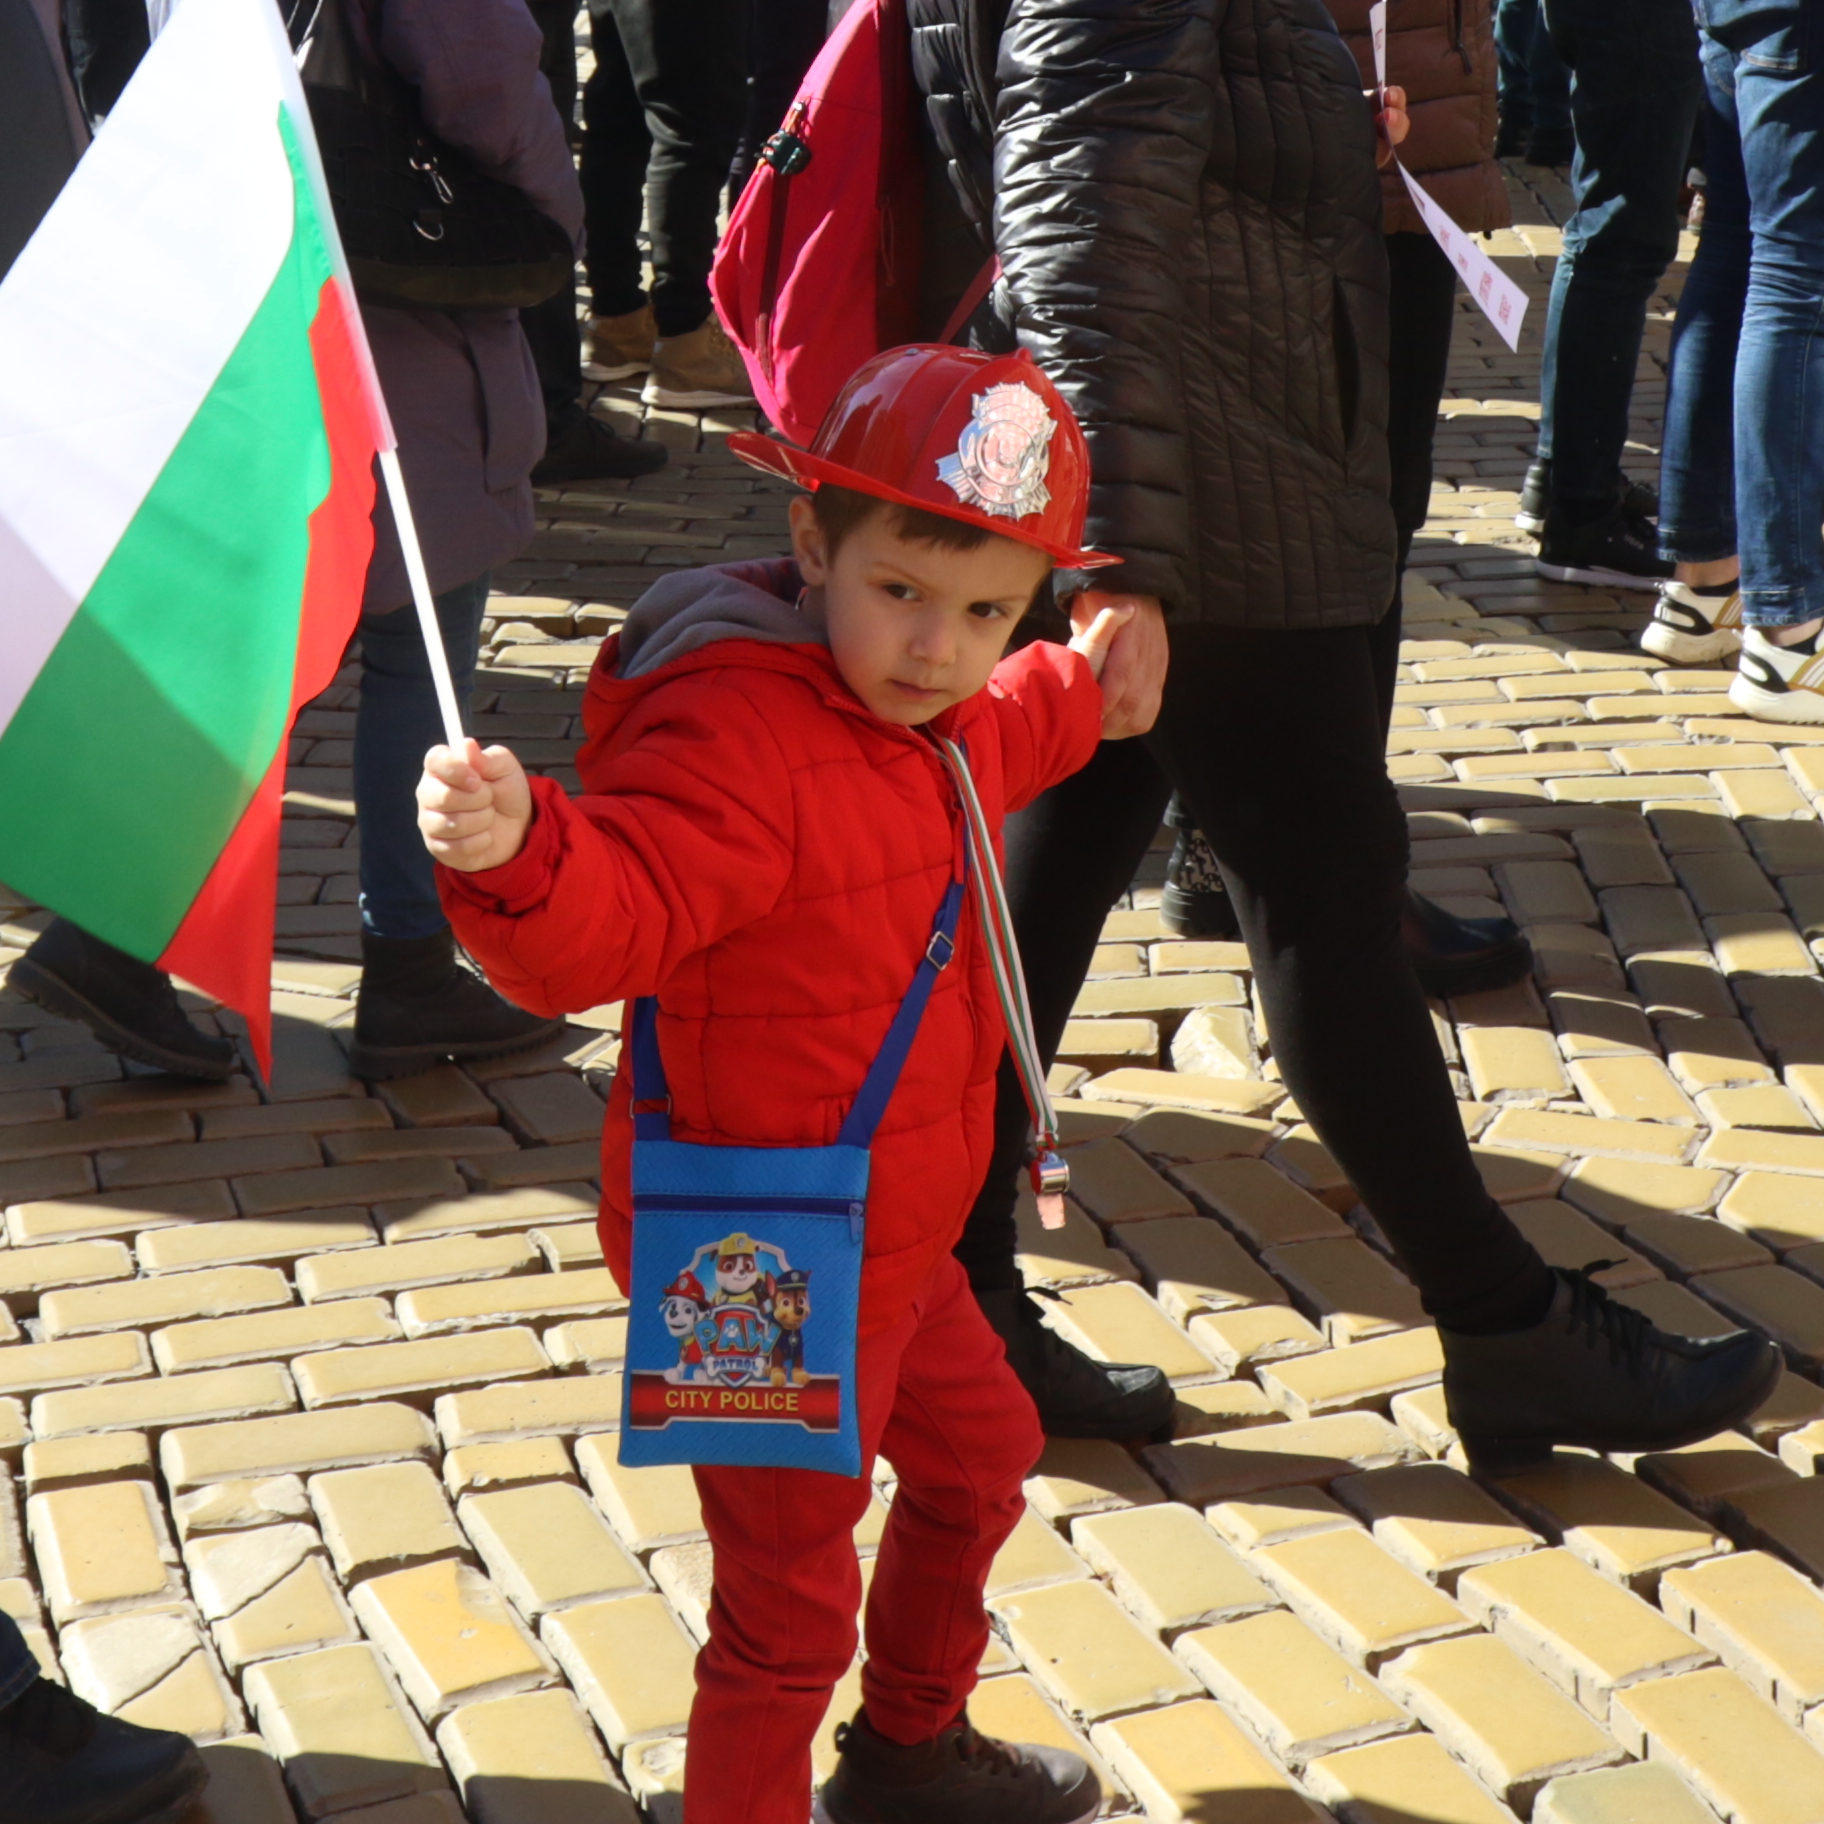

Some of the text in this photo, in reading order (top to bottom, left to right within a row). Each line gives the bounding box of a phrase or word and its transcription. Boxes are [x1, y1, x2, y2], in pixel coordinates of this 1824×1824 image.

[693, 1314, 782, 1356] PAW
[712, 1357, 759, 1372] PATROL
[664, 1390, 800, 1412] CITY POLICE
